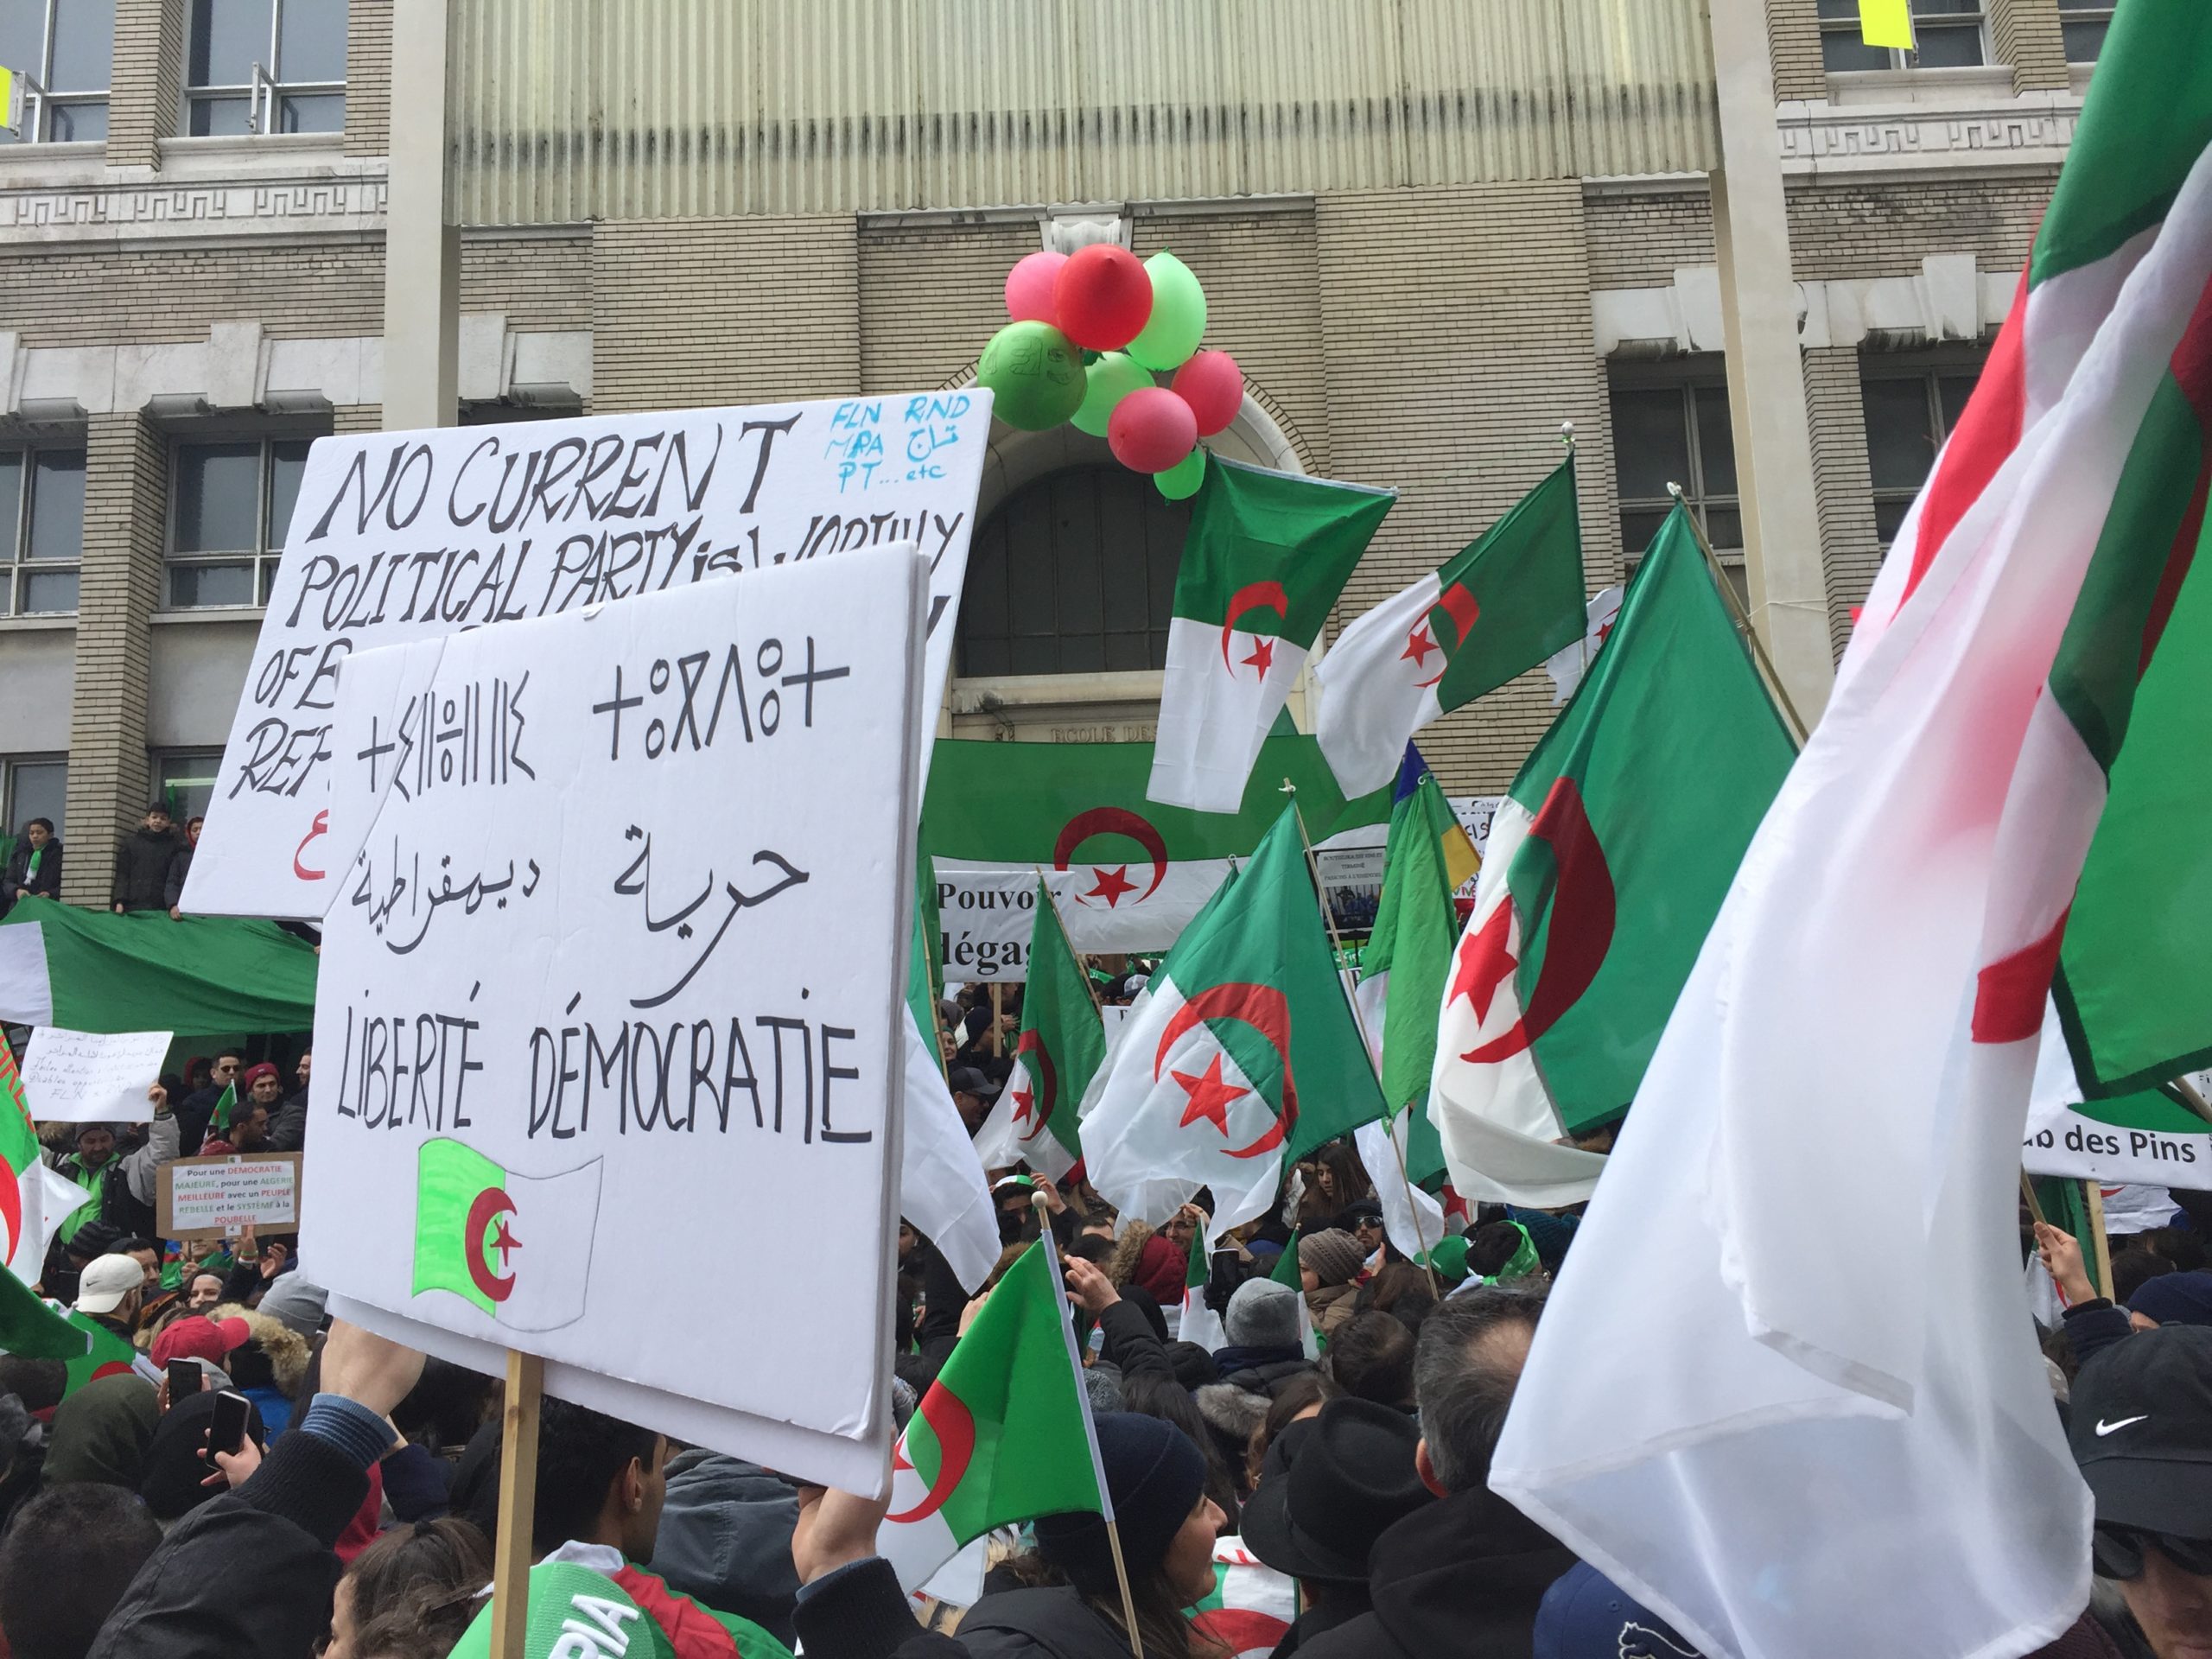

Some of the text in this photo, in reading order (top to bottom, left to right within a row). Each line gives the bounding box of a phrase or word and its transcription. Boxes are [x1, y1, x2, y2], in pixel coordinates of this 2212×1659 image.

[830, 395, 970, 432] FLN RND
[305, 411, 803, 543] NO CURRENT
[285, 538, 532, 631] POLITICAL
[537, 514, 703, 617] PARTY
[691, 539, 744, 583] is
[1051, 726, 1116, 743] ECOLE
[938, 882, 1062, 910] Pouvor
[352, 823, 810, 1008] حرية ديمقراطية
[941, 931, 1033, 976] éga
[529, 991, 872, 1144] DÉMOCRATIE
[2065, 1124, 2120, 1155] des
[2130, 1131, 2196, 1163] Pins
[175, 1180, 219, 1190] MAJEURE,
[178, 1192, 226, 1202] MEILLEURE
[261, 1188, 290, 1197] PEUPLE
[179, 1205, 214, 1214] REBELLE
[214, 1215, 257, 1224] POUBELLE
